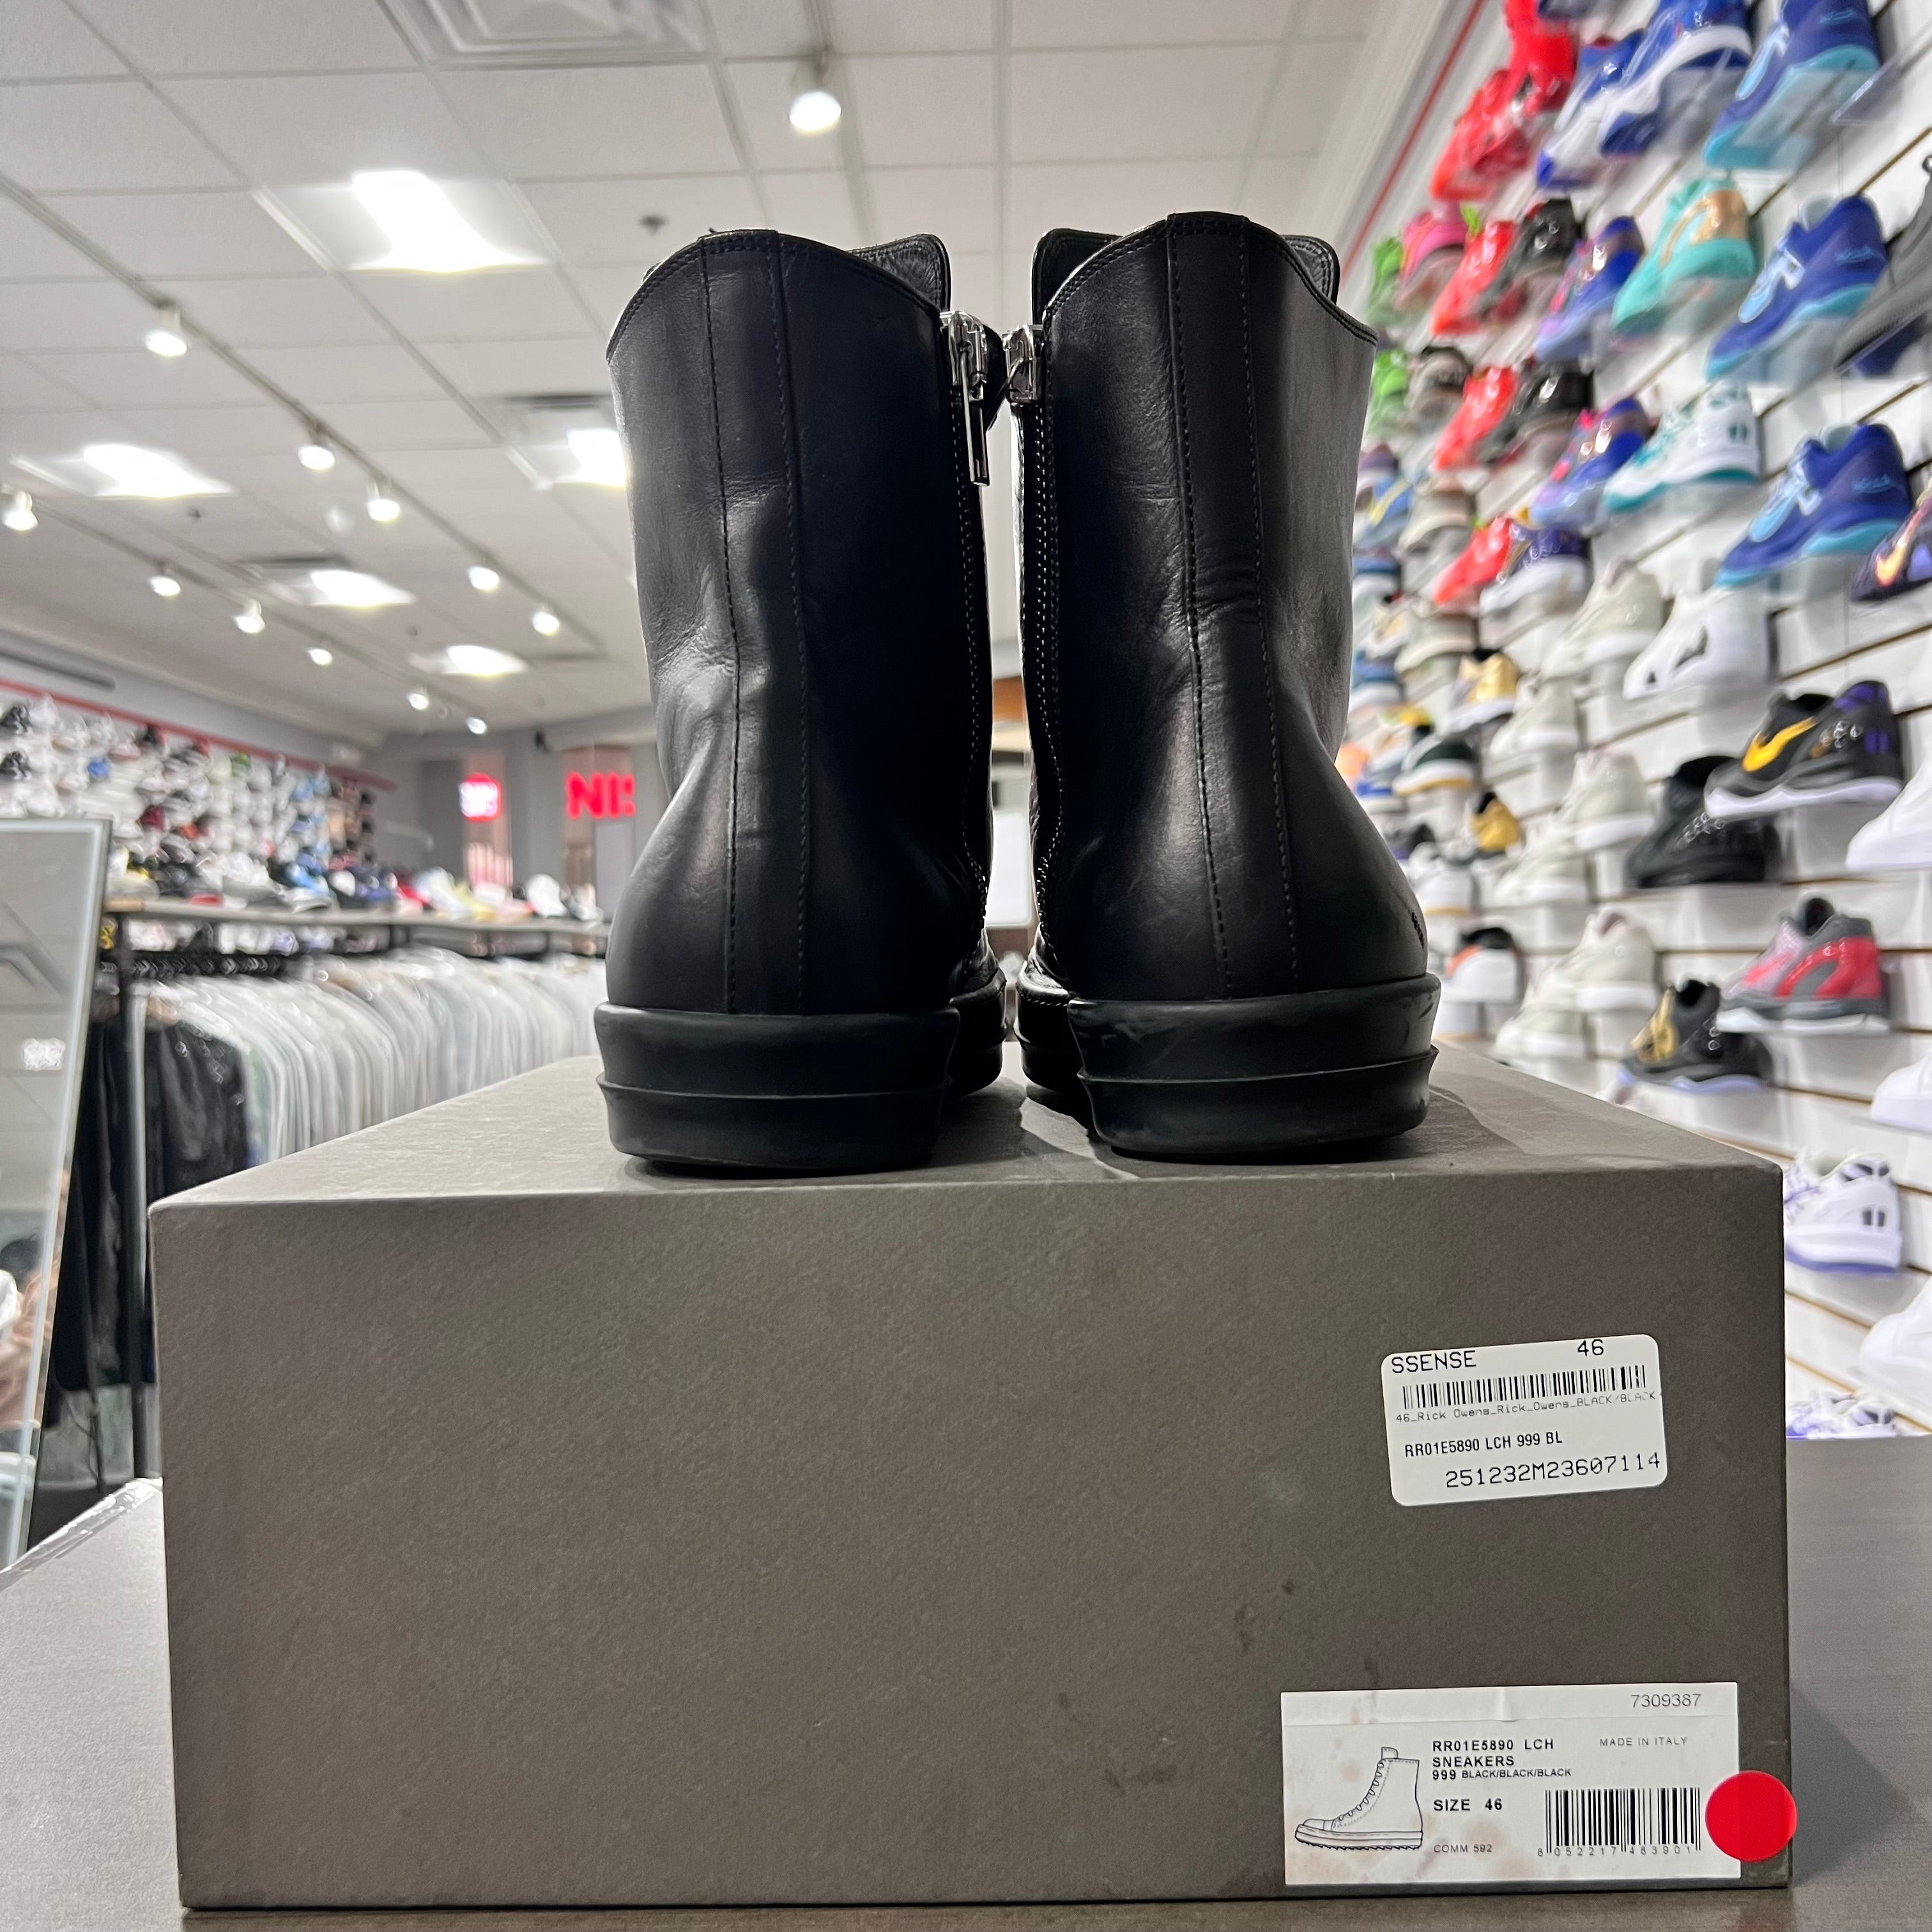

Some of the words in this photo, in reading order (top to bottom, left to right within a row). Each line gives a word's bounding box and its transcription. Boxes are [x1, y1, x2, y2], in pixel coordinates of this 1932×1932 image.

[1391, 1350, 1476, 1373] SSENSE
[1577, 1339, 1604, 1356] 46
[1453, 1392, 1661, 1418] Owens_Rick_Owens_BLACK/BLACK
[1405, 1438, 1480, 1457] RR01E5890
[1485, 1436, 1511, 1450] LCH
[1517, 1433, 1540, 1447] 999
[1545, 1431, 1563, 1445] BL
[1445, 1452, 1660, 1488] 251232M23607114
[1630, 1693, 1702, 1708] 7309387
[1432, 1739, 1514, 1752] RR01E5890
[1524, 1738, 1554, 1751] LCH
[1599, 1737, 1633, 1746] MADE
[1638, 1737, 1649, 1745] IN
[1655, 1736, 1687, 1745] ITALY
[1432, 1756, 1515, 1768] SNEAKERS
[1432, 1769, 1457, 1781] 999
[1462, 1768, 1572, 1779] BLACK/BLACK/BLACK
[1433, 1798, 1471, 1811] SIZE
[1484, 1798, 1503, 1810] 46
[1433, 1844, 1468, 1853] COMM
